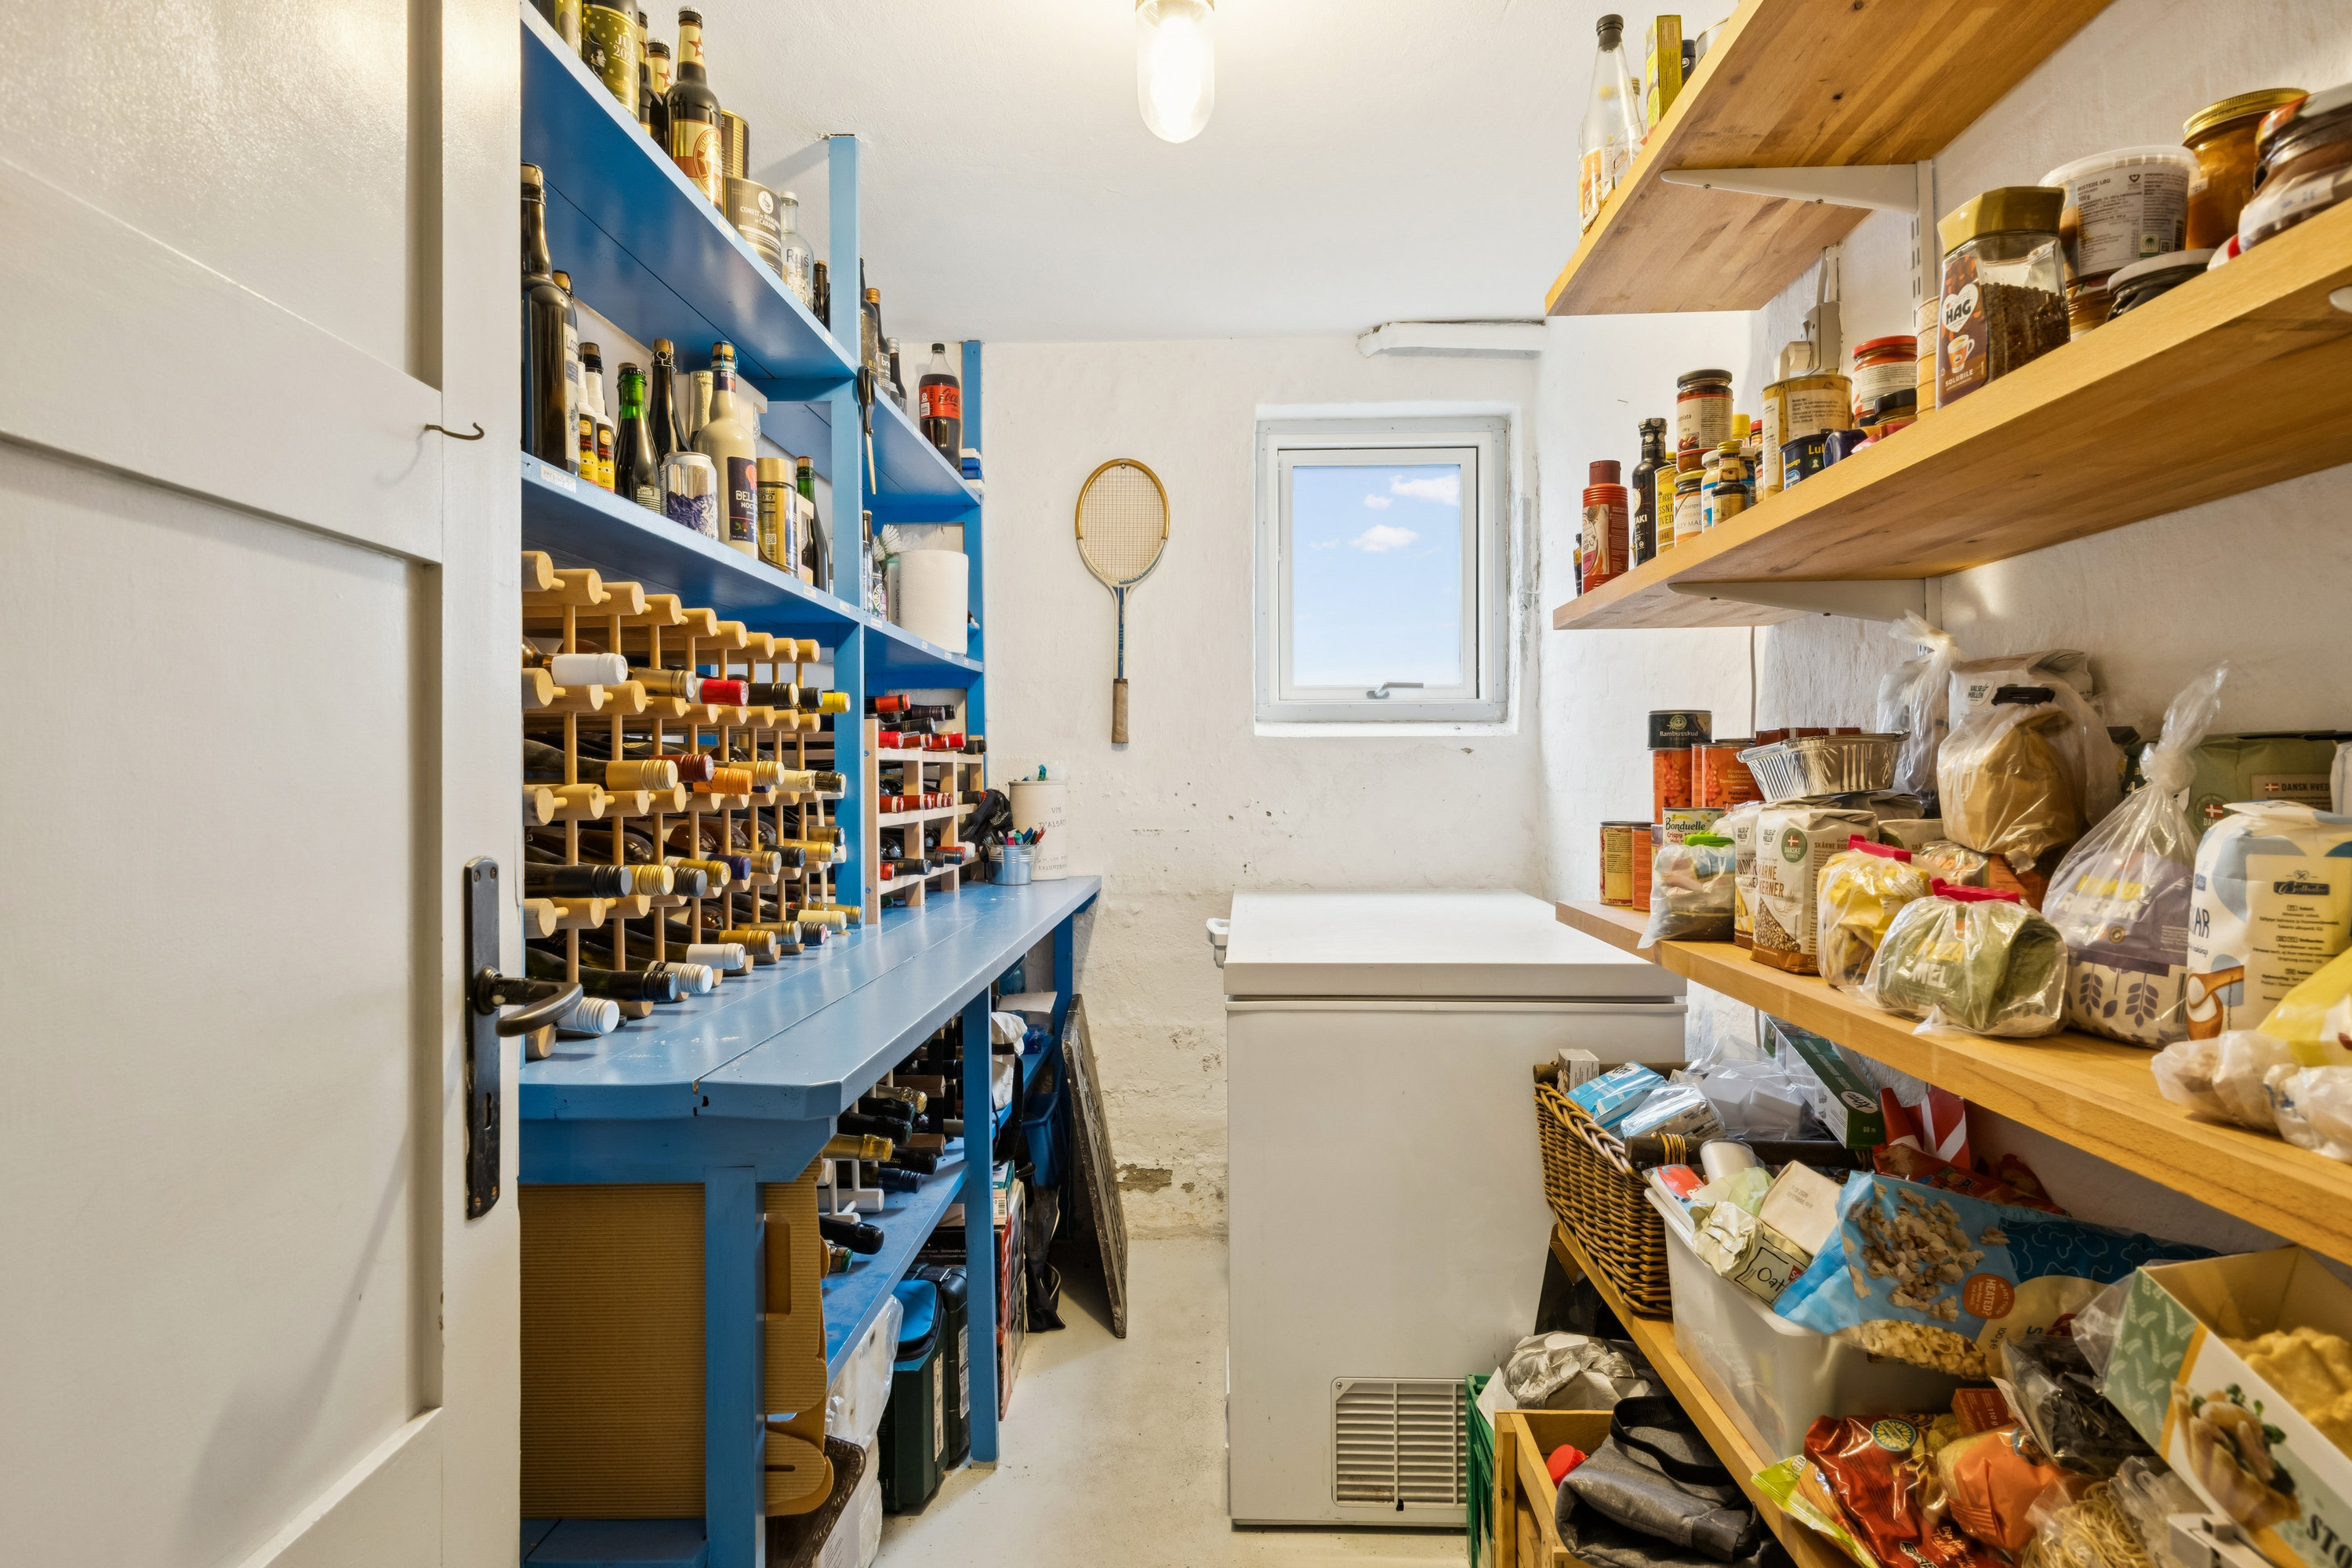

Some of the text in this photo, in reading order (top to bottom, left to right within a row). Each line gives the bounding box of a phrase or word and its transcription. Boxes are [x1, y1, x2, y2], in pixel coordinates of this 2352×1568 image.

[740, 205, 760, 217] CONFIT
[1946, 299, 1972, 325] HAG
[1944, 368, 1973, 387] SOLUBILE
[2281, 783, 2308, 792] DANSK
[1665, 817, 1706, 832] Bonduelle
[1667, 831, 1683, 840] Crispy
[1784, 847, 1802, 855] DANSKE
[1814, 840, 1836, 850] SKÅRNE
[1757, 1267, 1786, 1292] Oat
[1982, 1279, 1997, 1316] HEATED?
[1987, 1408, 1995, 1420] 110
[1941, 1526, 1954, 1540] Dip
